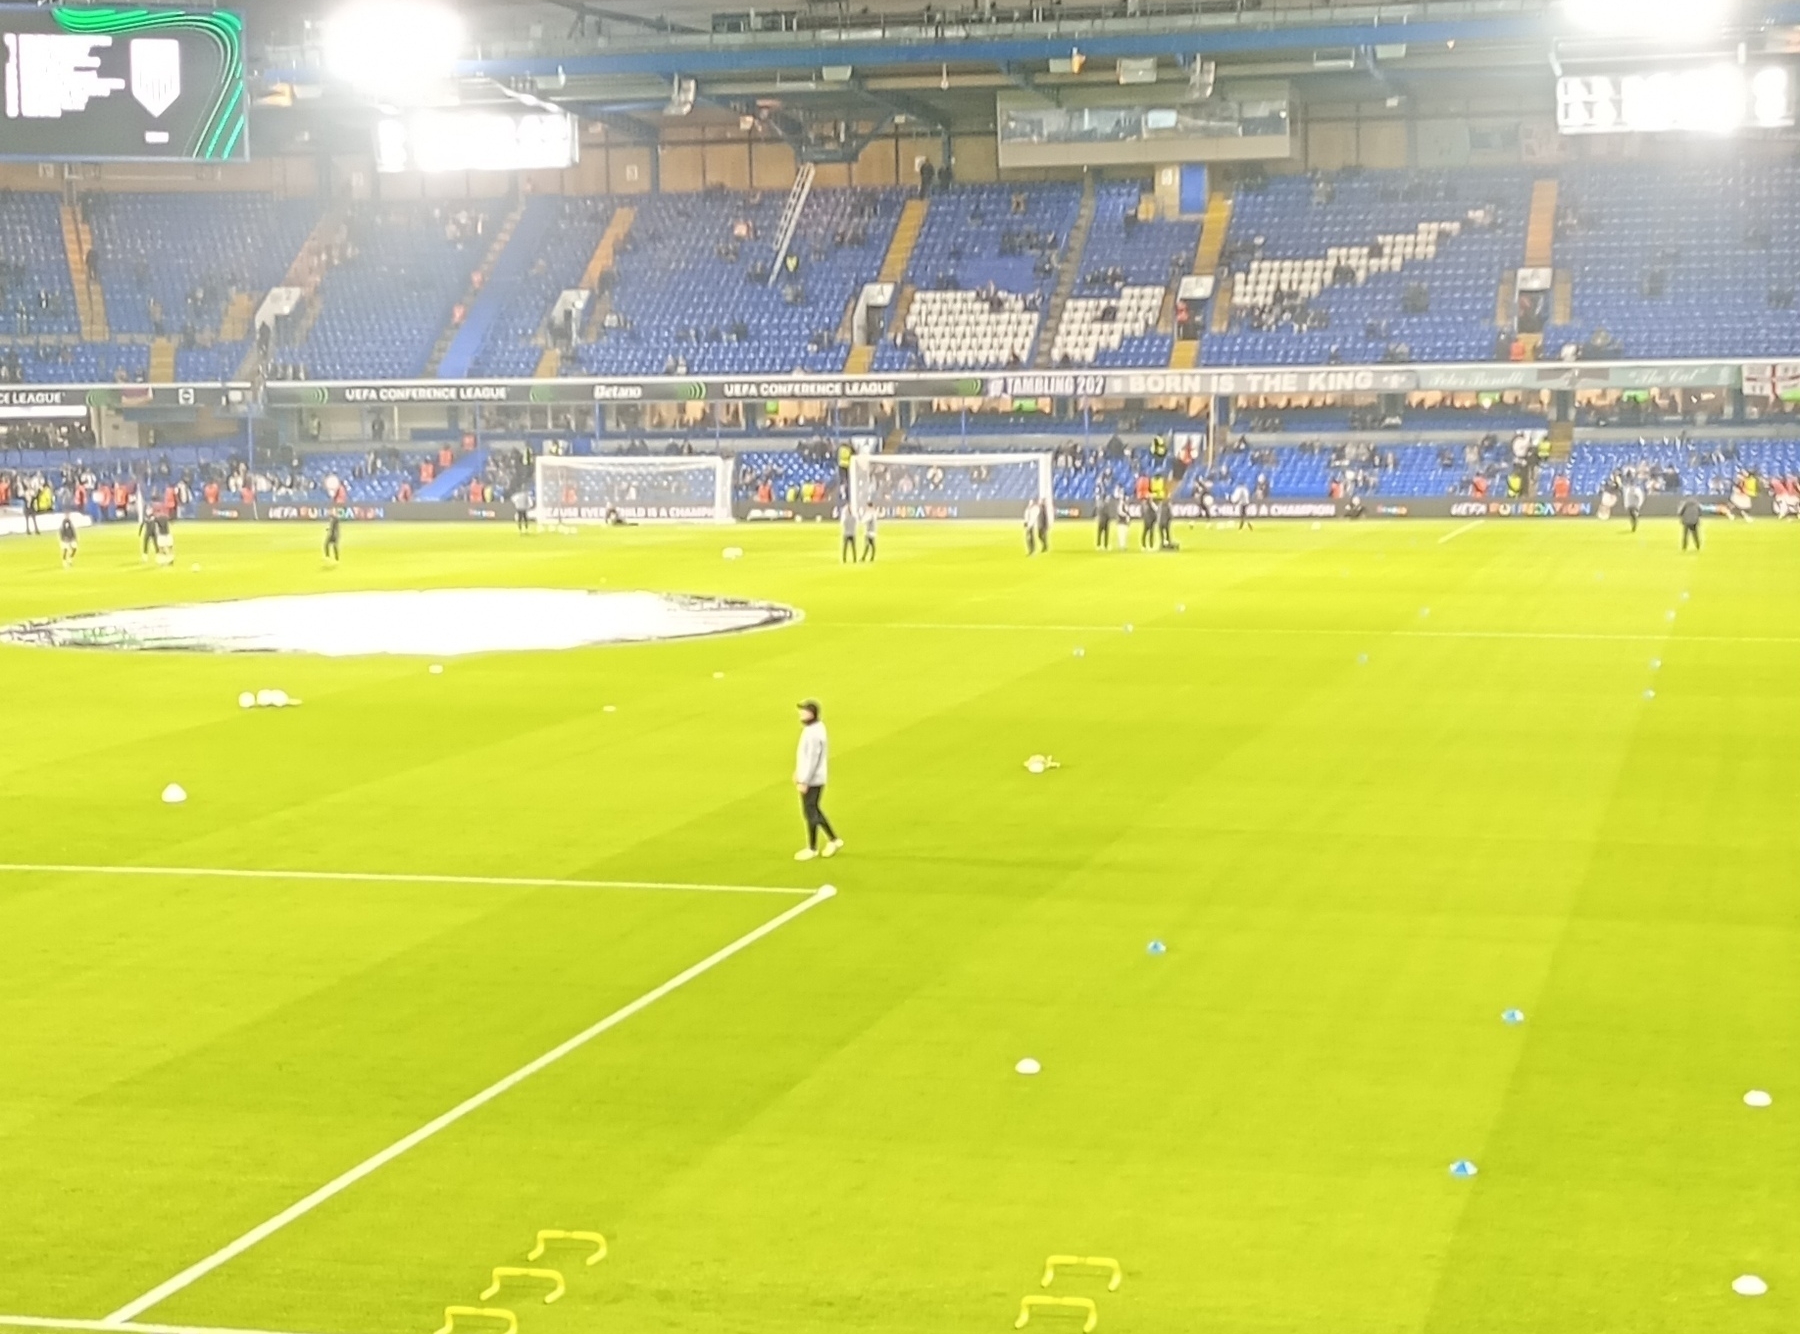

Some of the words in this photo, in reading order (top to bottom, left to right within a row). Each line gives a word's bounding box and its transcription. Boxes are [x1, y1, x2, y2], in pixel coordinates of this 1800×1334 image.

[724, 383, 758, 397] UEFA
[760, 382, 842, 396] CONFERENCE
[844, 381, 896, 395] LEAGUE
[1129, 374, 1200, 394] BORN
[1211, 373, 1235, 392] IS
[1246, 372, 1299, 392] THE
[1308, 370, 1374, 391] KING
[12, 391, 61, 404] LEAGUE
[345, 387, 377, 401] UEFA
[379, 387, 457, 401] CONFERENCE
[459, 386, 507, 400] LEAGUE
